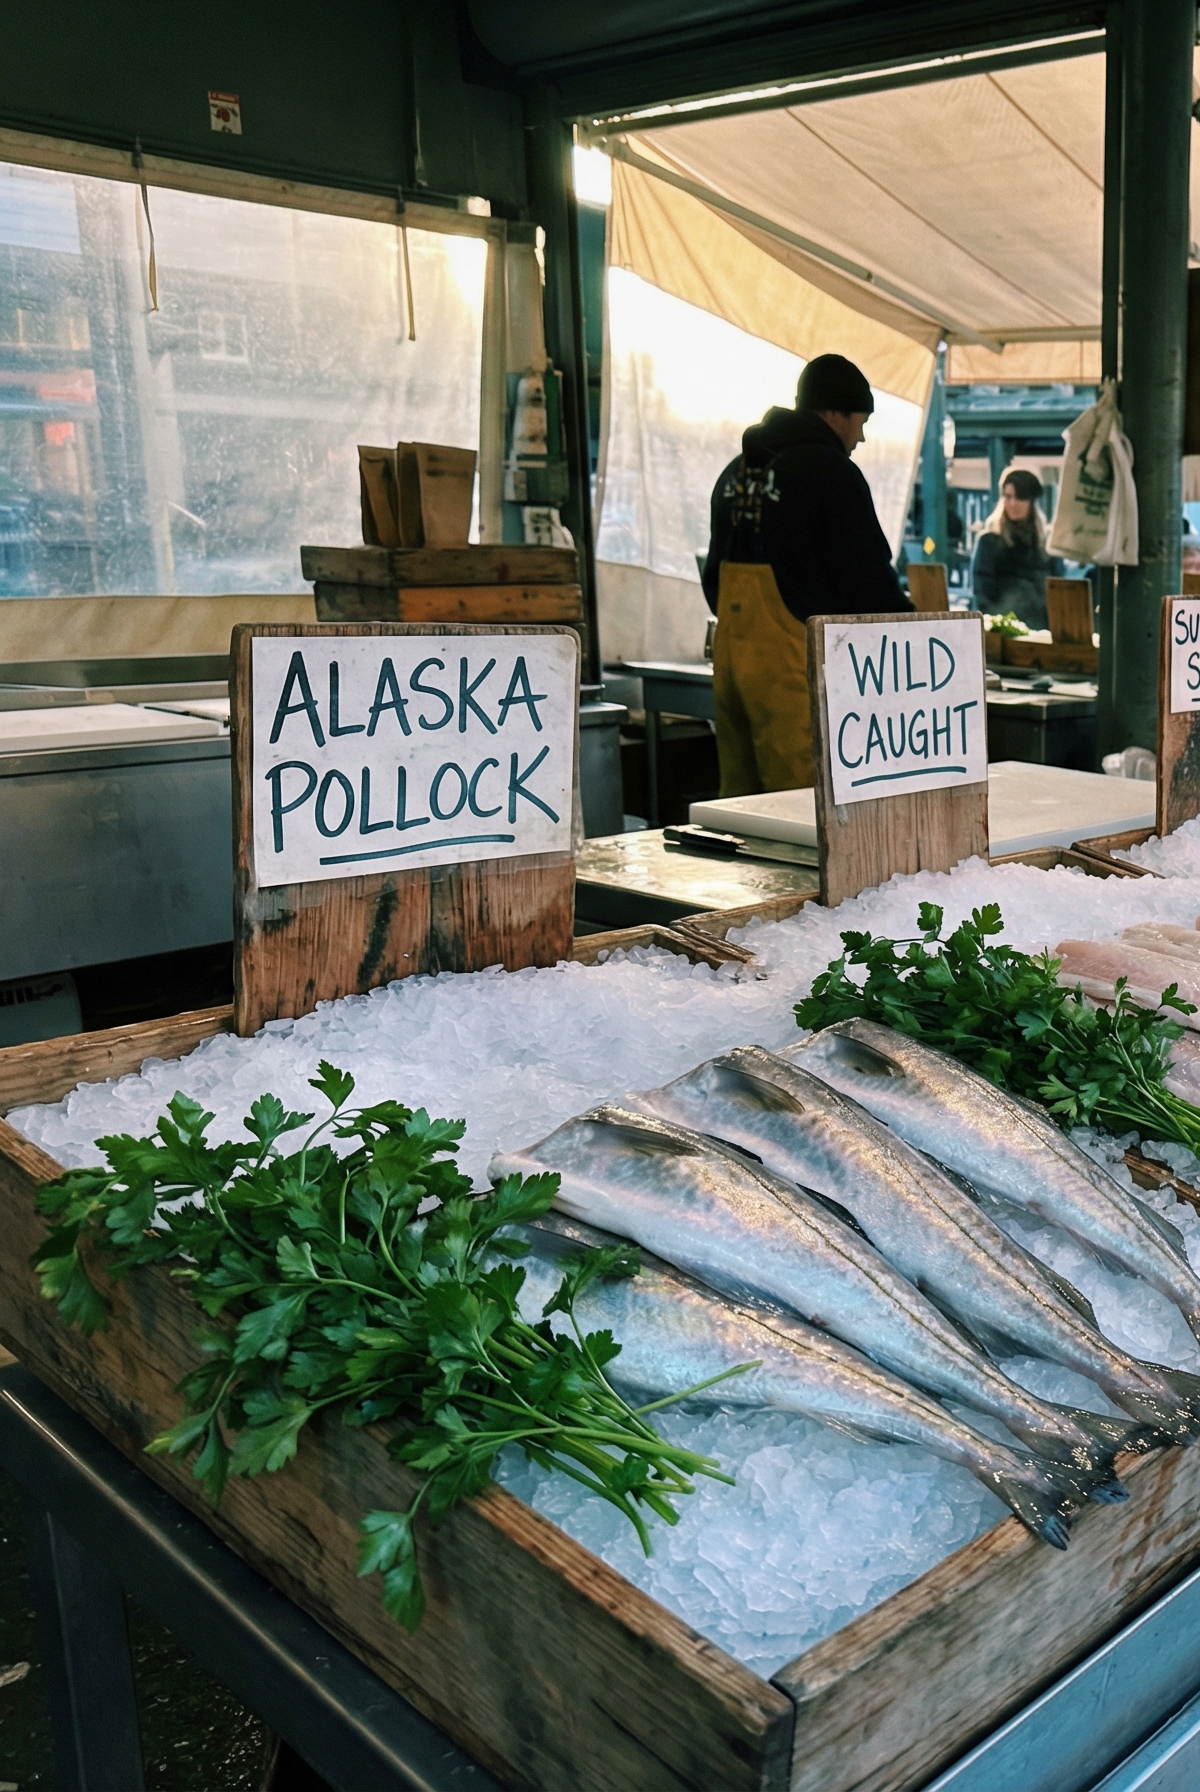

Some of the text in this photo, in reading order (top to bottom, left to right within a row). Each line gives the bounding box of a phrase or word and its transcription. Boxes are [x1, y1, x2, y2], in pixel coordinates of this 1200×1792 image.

[268, 650, 549, 748] ALASKA
[847, 634, 956, 697] WILD
[837, 700, 978, 769] CAUGHT
[264, 745, 560, 854] POLLOCK
